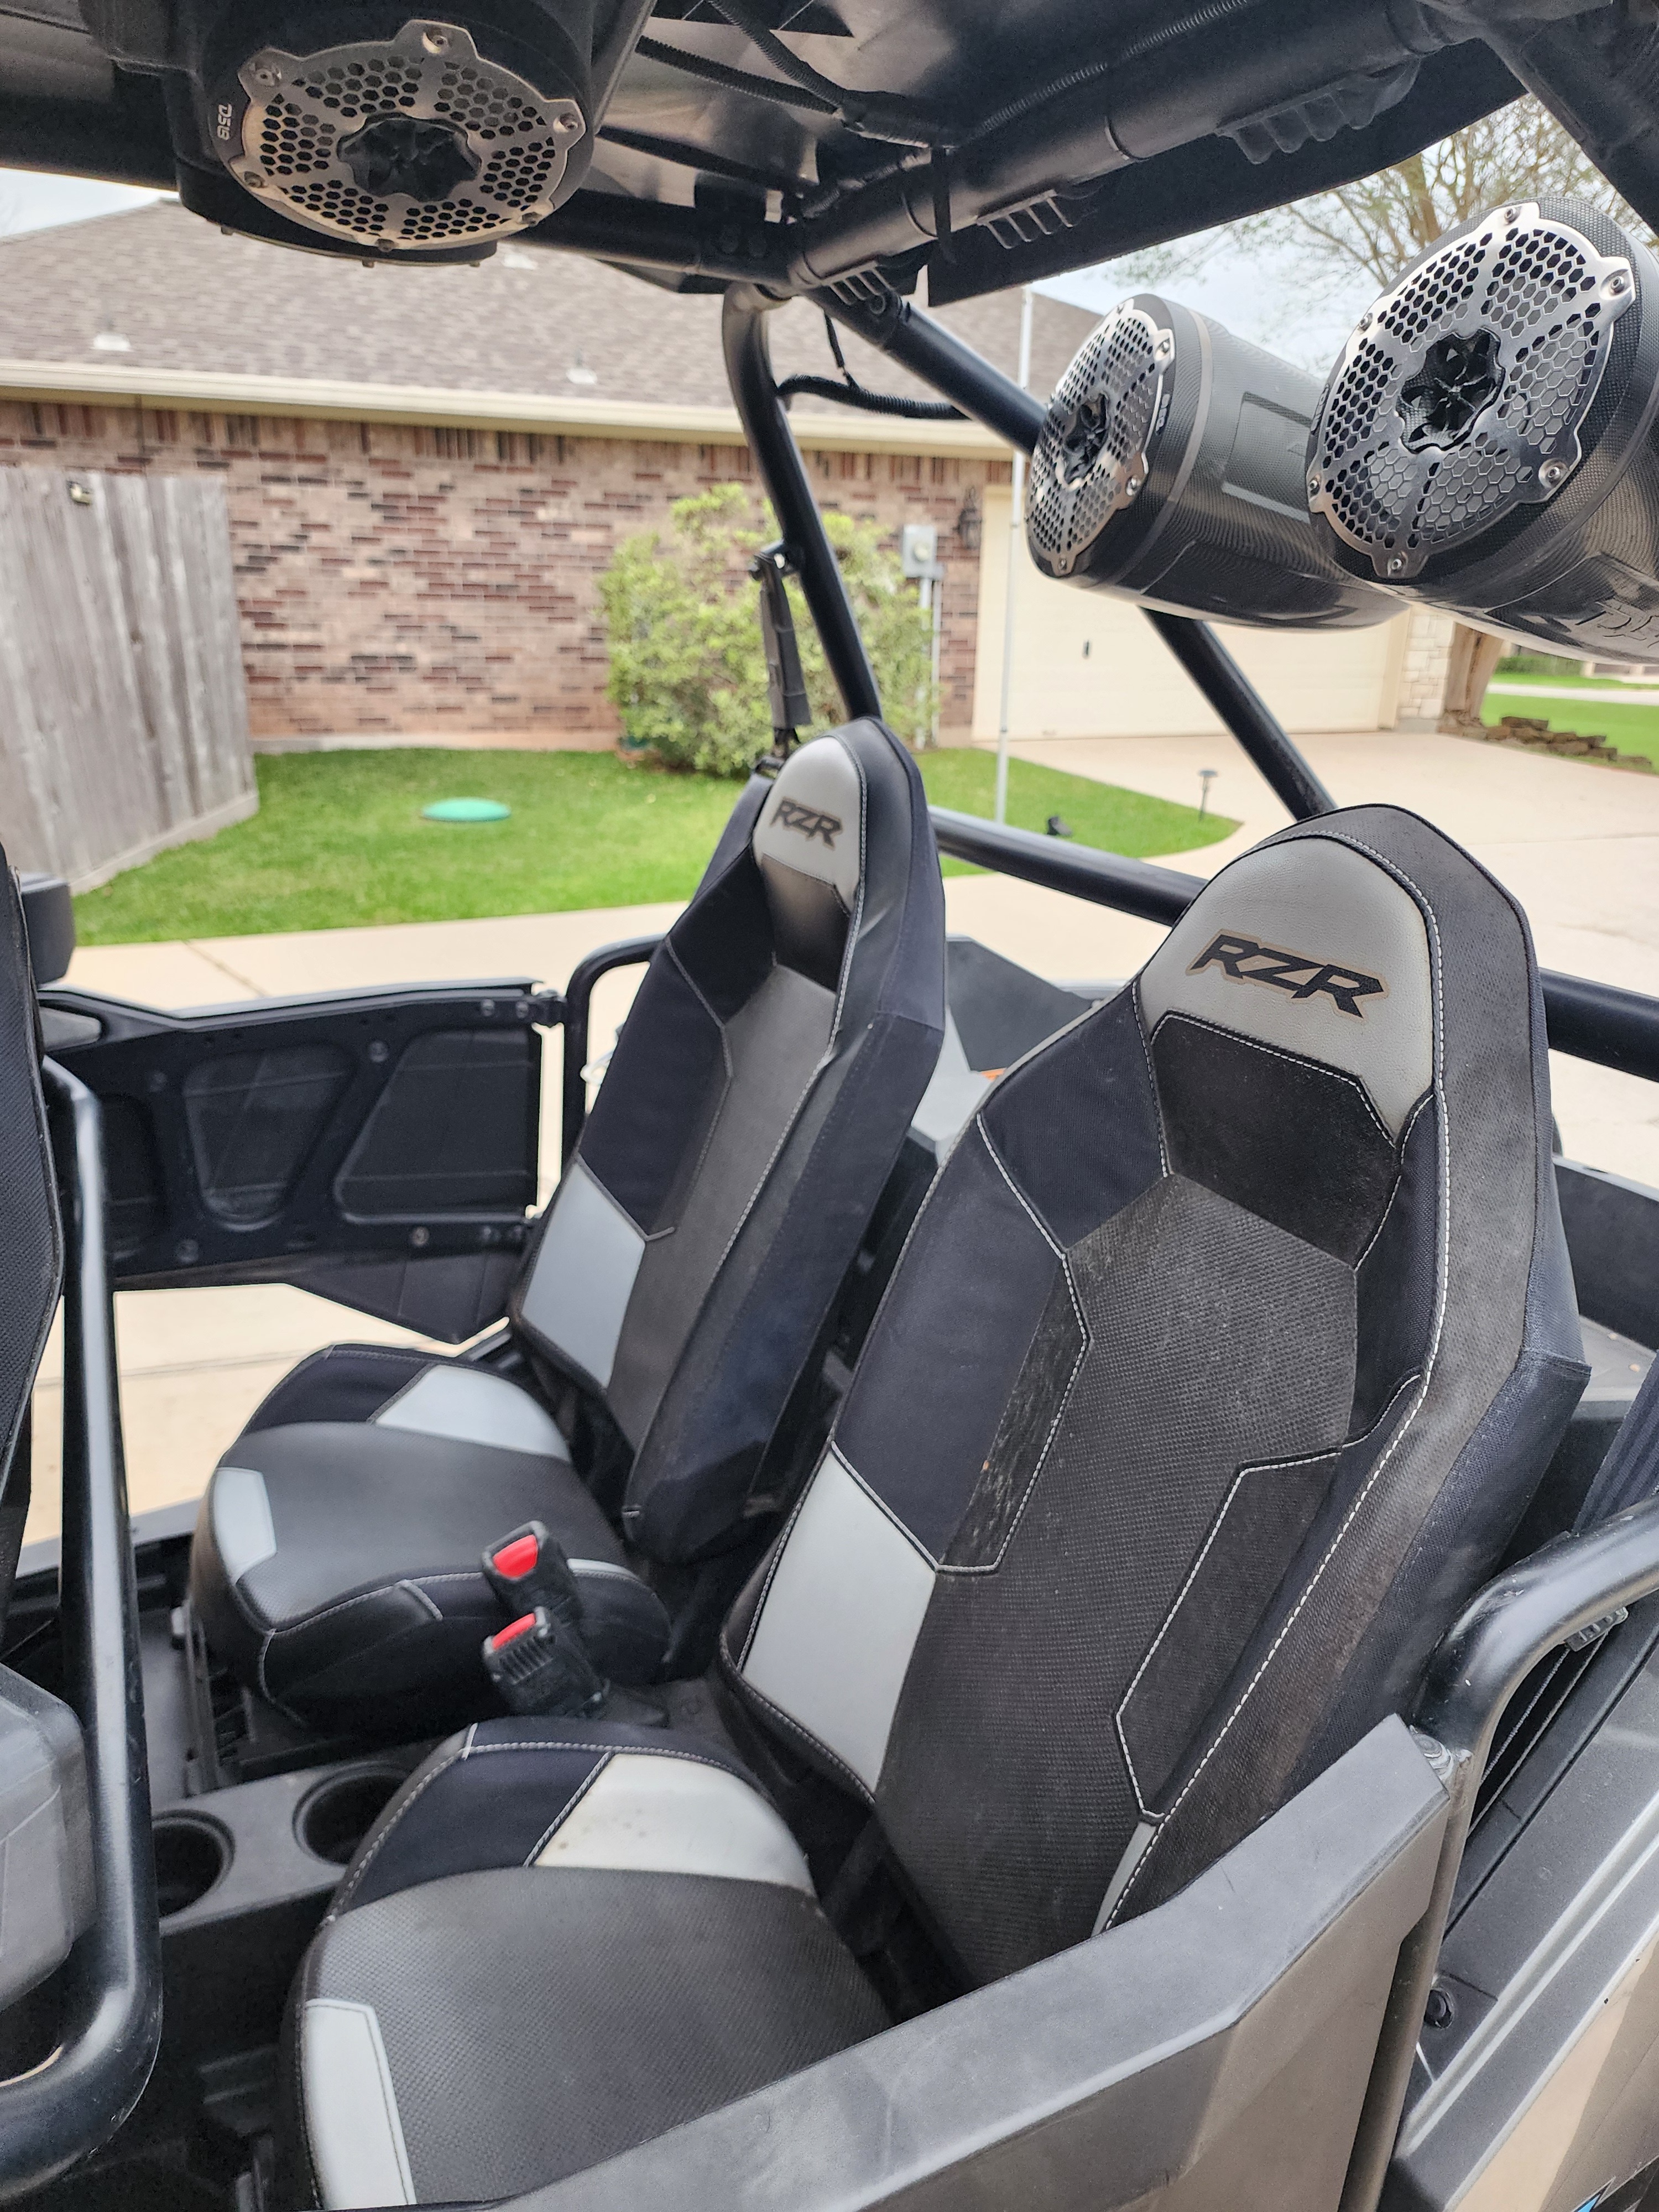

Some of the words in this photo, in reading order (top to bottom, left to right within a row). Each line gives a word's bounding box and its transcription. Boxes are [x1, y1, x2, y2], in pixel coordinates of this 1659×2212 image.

[217, 103, 232, 141] DS18
[770, 799, 843, 850] RZR
[1188, 932, 1387, 1022] RZR
